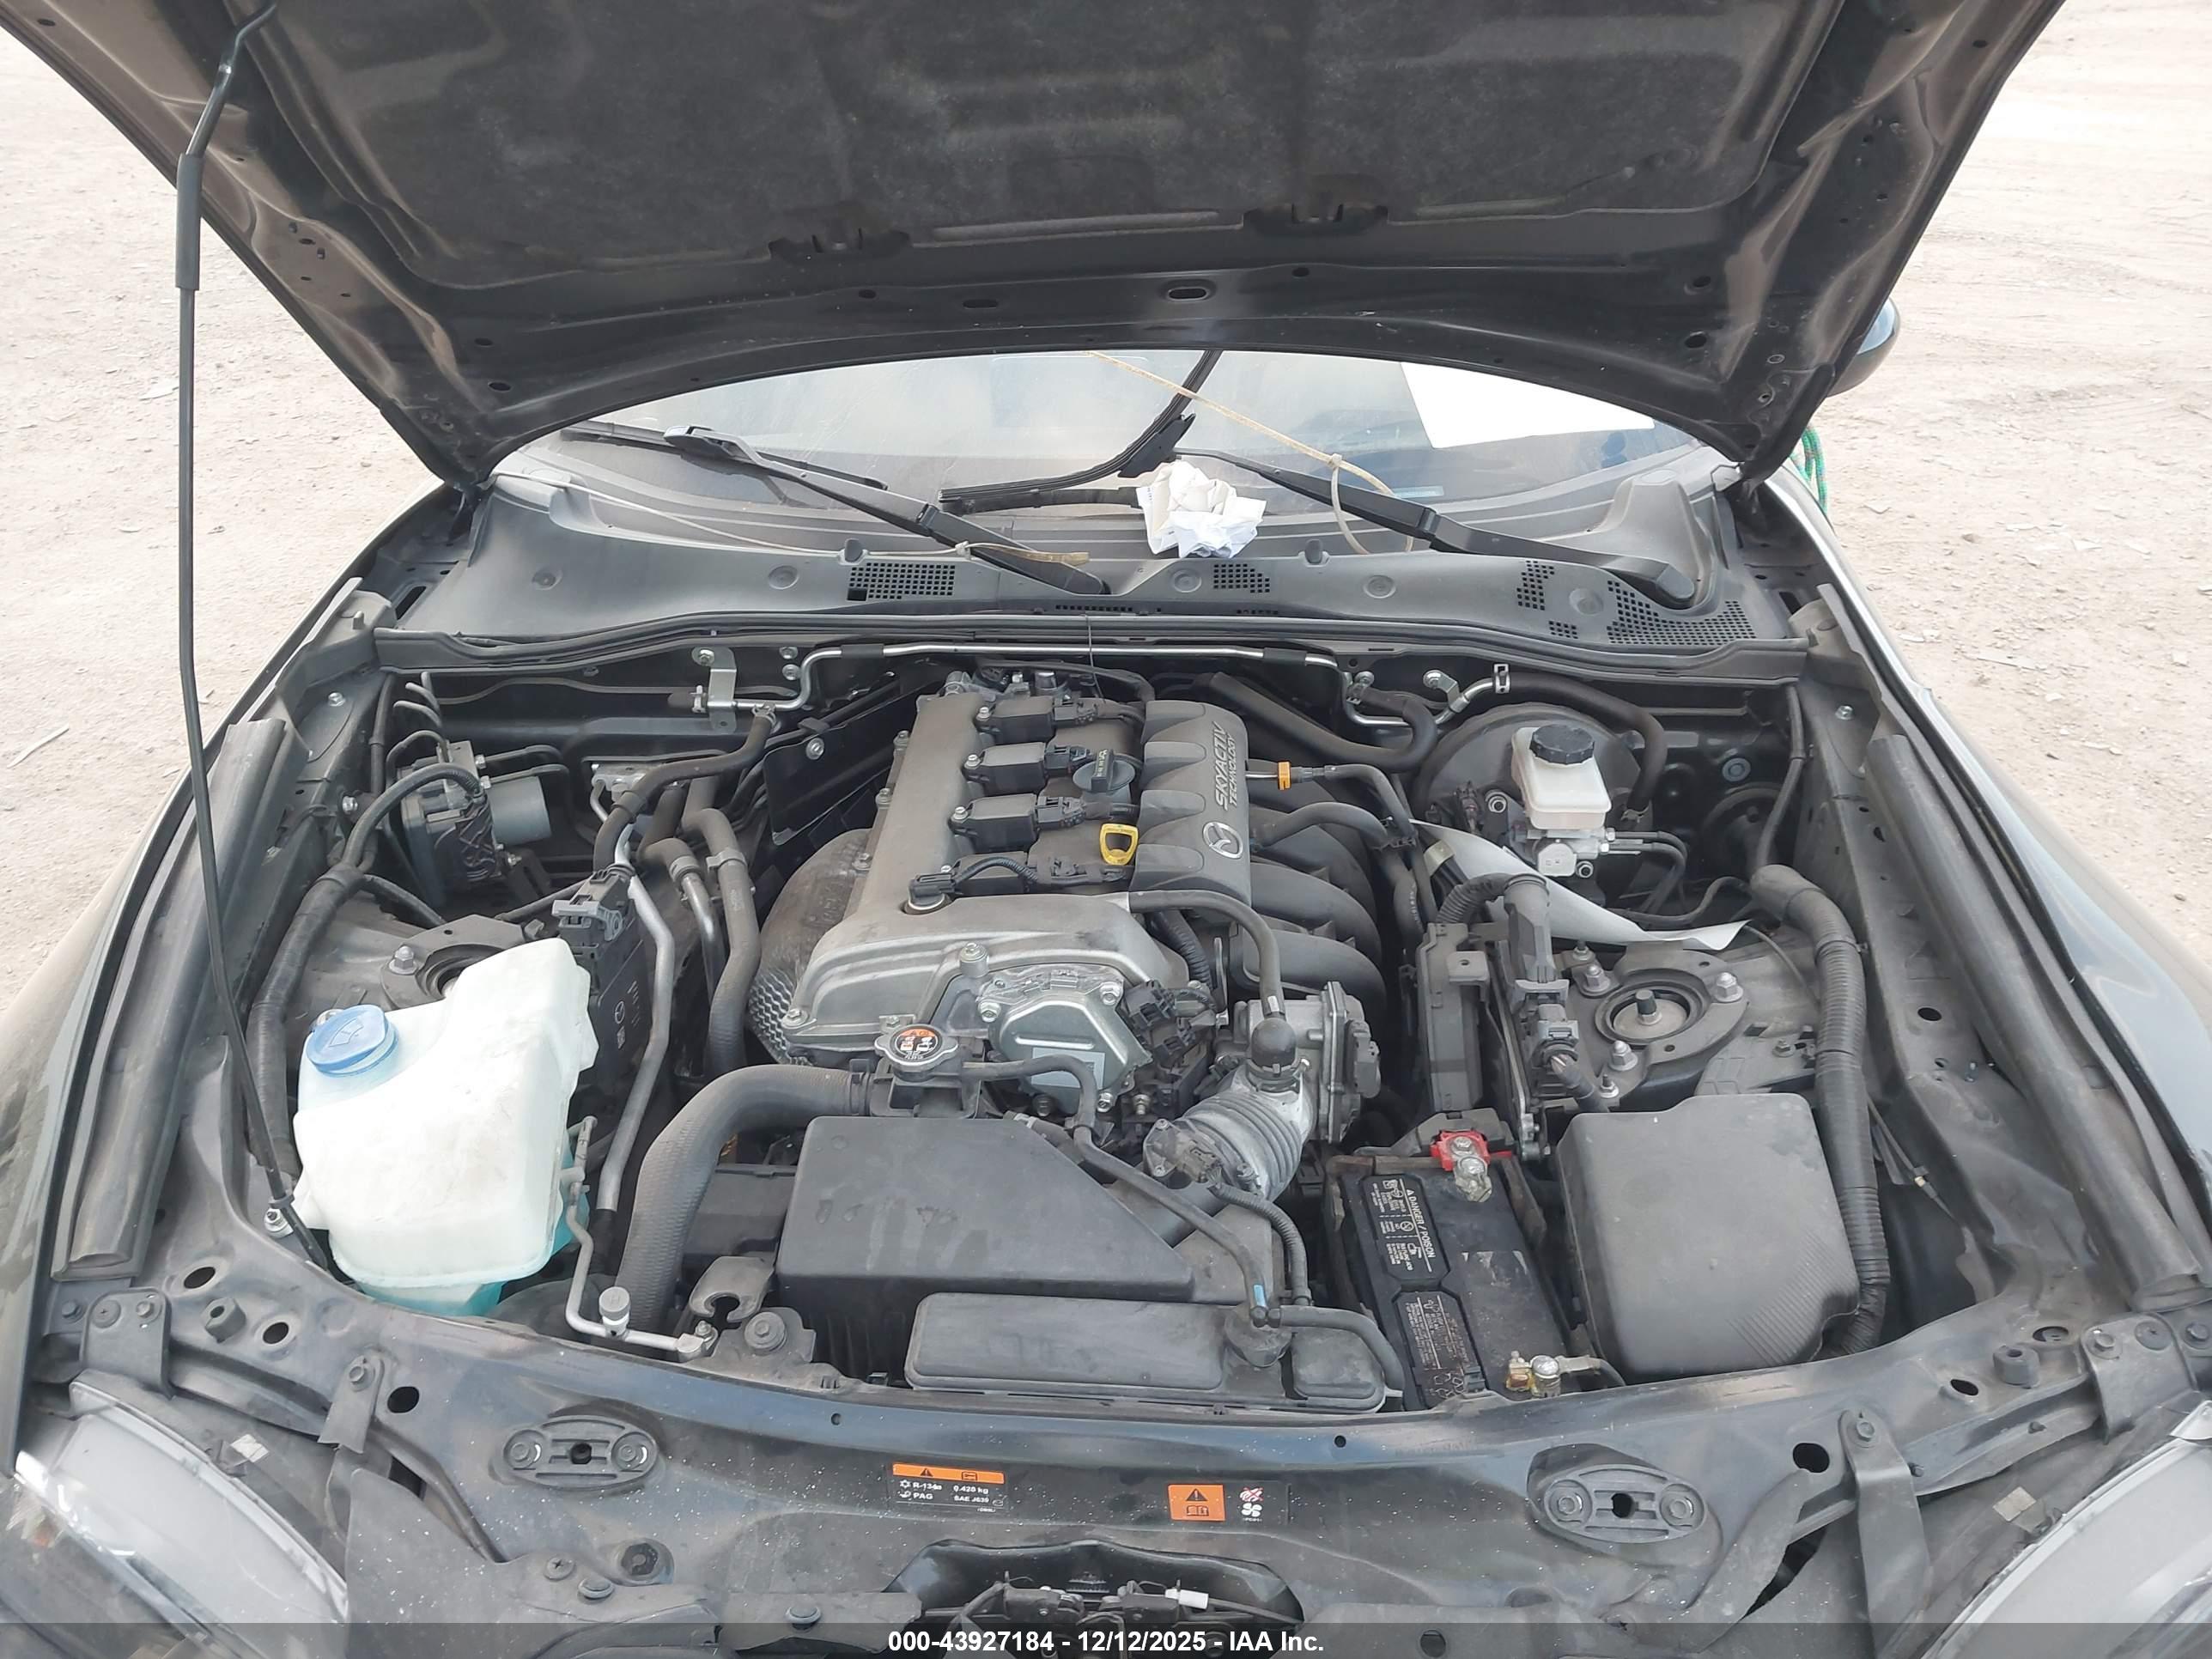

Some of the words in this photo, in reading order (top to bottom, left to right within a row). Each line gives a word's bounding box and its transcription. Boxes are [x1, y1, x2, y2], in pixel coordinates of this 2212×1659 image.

[1213, 721, 1229, 811] SKYACTIV
[1226, 733, 1237, 808] TECHNOLOGY
[1408, 1195, 1425, 1224] DANGER
[1419, 1231, 1436, 1258] POISON
[913, 1482, 943, 1491] R-134a
